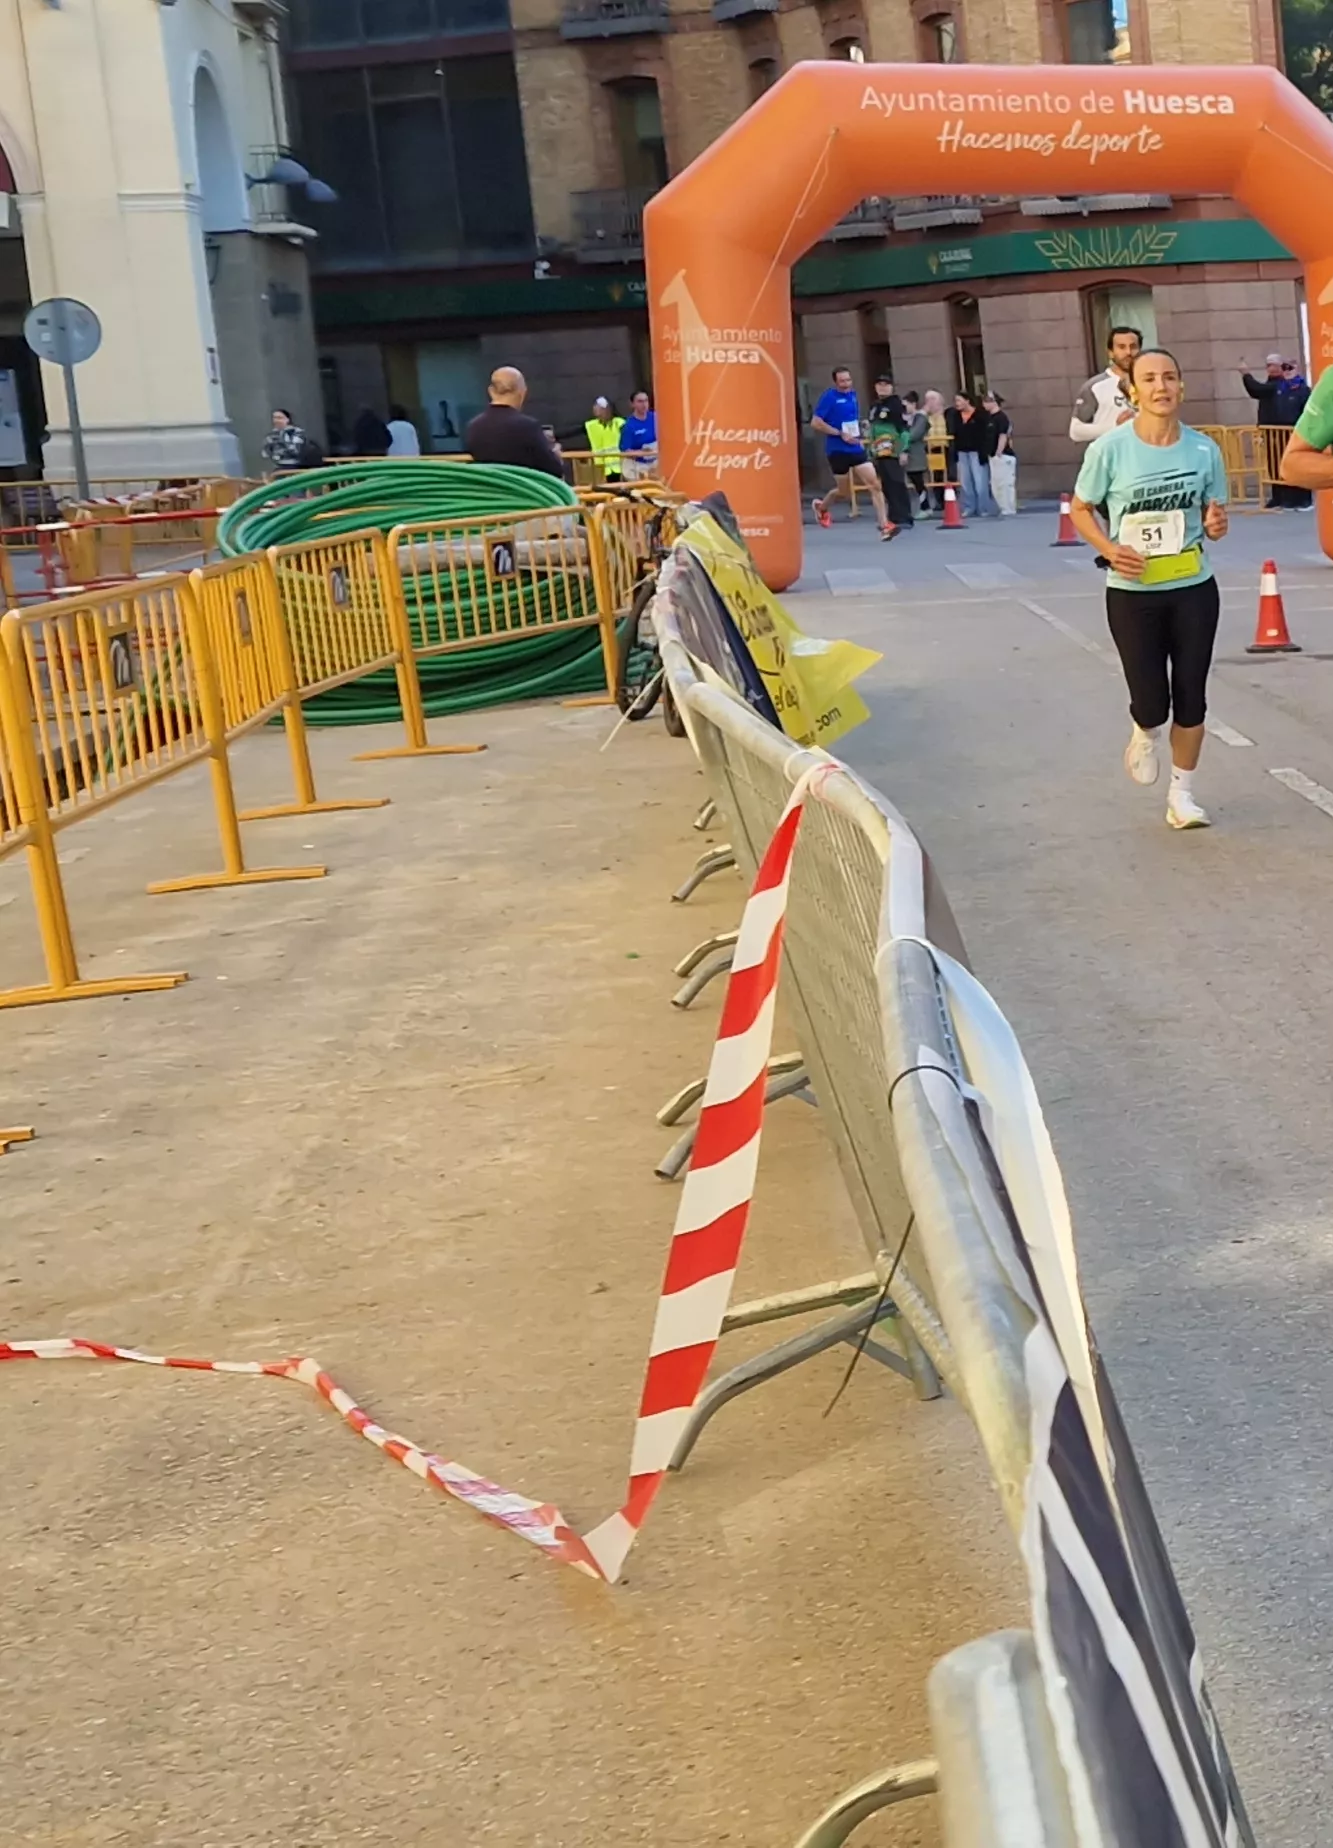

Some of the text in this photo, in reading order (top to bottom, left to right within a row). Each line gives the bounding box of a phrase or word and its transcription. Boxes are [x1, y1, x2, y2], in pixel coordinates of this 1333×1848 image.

[860, 86, 1235, 118] Ayuntamiento de Huesca
[937, 119, 1164, 165] Hacemos deporte
[662, 324, 782, 346] Ayuntamiento
[664, 346, 760, 364] de Huesca
[692, 419, 781, 448] Hacemos
[694, 443, 772, 480] deporte
[1141, 526, 1163, 541] 51
